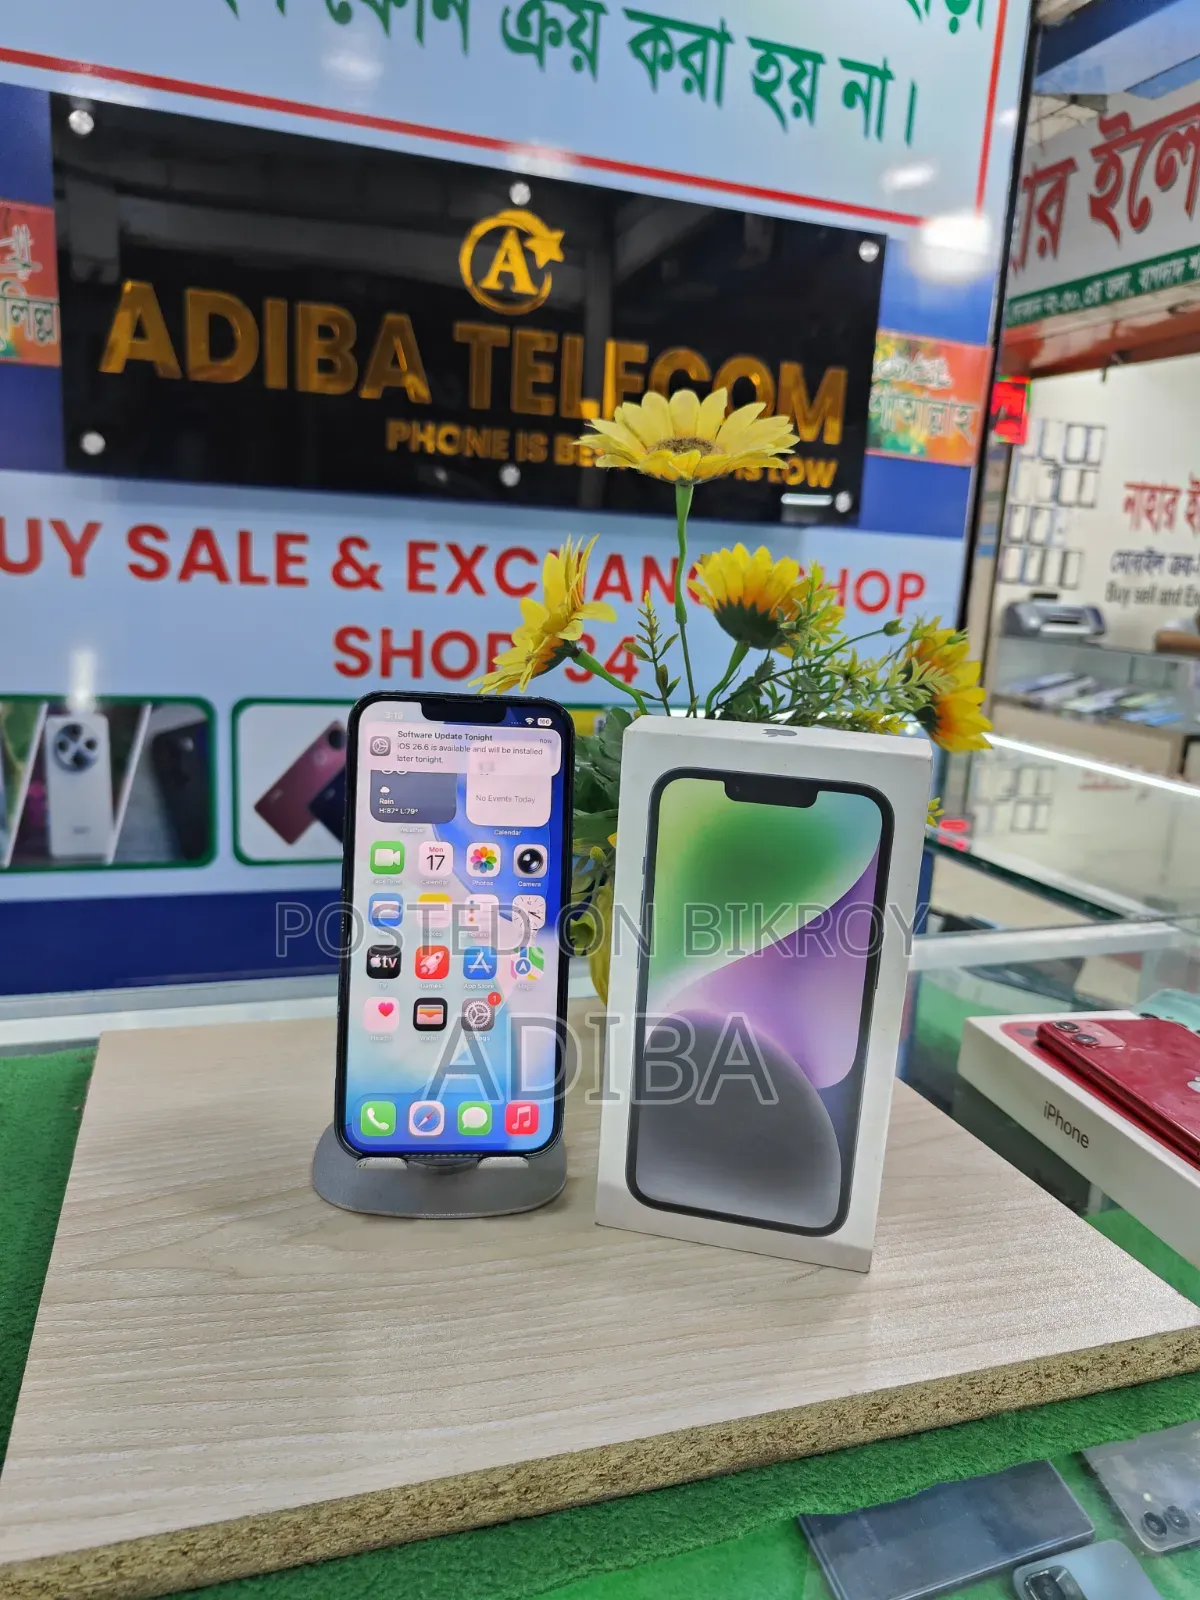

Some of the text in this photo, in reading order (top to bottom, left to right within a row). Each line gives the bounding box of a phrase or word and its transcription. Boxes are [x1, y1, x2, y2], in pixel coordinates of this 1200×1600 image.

[621, 7, 736, 109] করা
[746, 36, 827, 134] হয়
[98, 279, 432, 405] ADIBA
[453, 320, 848, 445] TELECOM
[385, 418, 510, 461] PHONE
[514, 428, 549, 463] IS
[124, 522, 310, 588] SALE
[330, 534, 384, 592] &
[799, 566, 927, 615] HOP
[397, 730, 493, 742] Software Update Tonight
[397, 742, 411, 750] iOS
[412, 743, 430, 751] 26.6
[438, 744, 471, 753] available
[472, 745, 487, 753] and
[488, 746, 500, 754] will
[501, 746, 511, 754] be
[512, 747, 543, 756] installed
[396, 754, 444, 765] later tonight.
[379, 797, 394, 805] Rain
[475, 794, 536, 804] No Events Today
[426, 854, 446, 871] 17
[517, 880, 542, 888] Camera
[1043, 1100, 1090, 1149] iPhone
